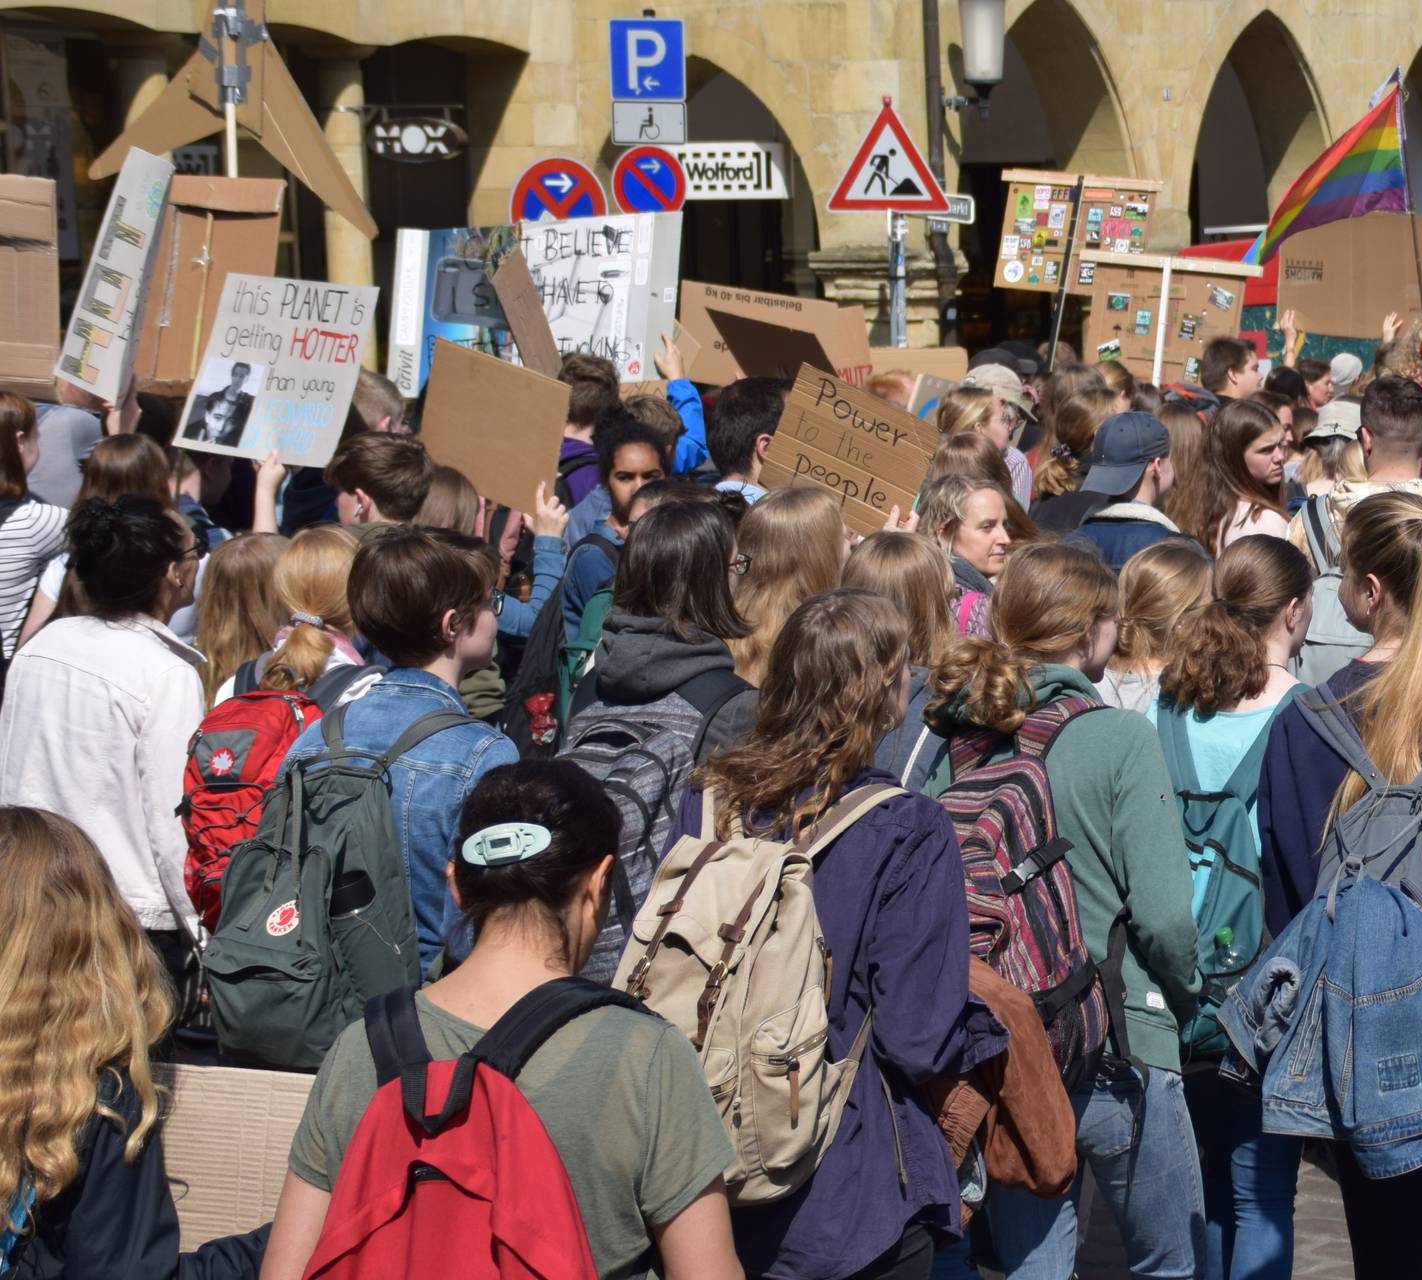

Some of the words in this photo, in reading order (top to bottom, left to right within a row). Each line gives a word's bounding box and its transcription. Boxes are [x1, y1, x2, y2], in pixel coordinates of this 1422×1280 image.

[627, 29, 667, 91] P
[375, 125, 448, 155] MOX
[685, 160, 755, 182] Wolford
[951, 201, 969, 217] arkt
[544, 225, 633, 262] BELIEVE
[232, 280, 273, 317] this
[280, 283, 349, 324] PLANET
[350, 297, 366, 326] is
[705, 286, 718, 299] kg
[720, 290, 733, 302] 40
[735, 293, 751, 305] bis
[753, 295, 803, 312] Belastbar
[221, 323, 283, 365] getting
[290, 328, 359, 364] HOTTER
[265, 367, 296, 392] than
[301, 377, 336, 401] young
[397, 350, 415, 392] crivit
[815, 377, 908, 448] Power
[793, 410, 820, 444] to
[836, 431, 874, 469] the
[792, 453, 887, 514] people
